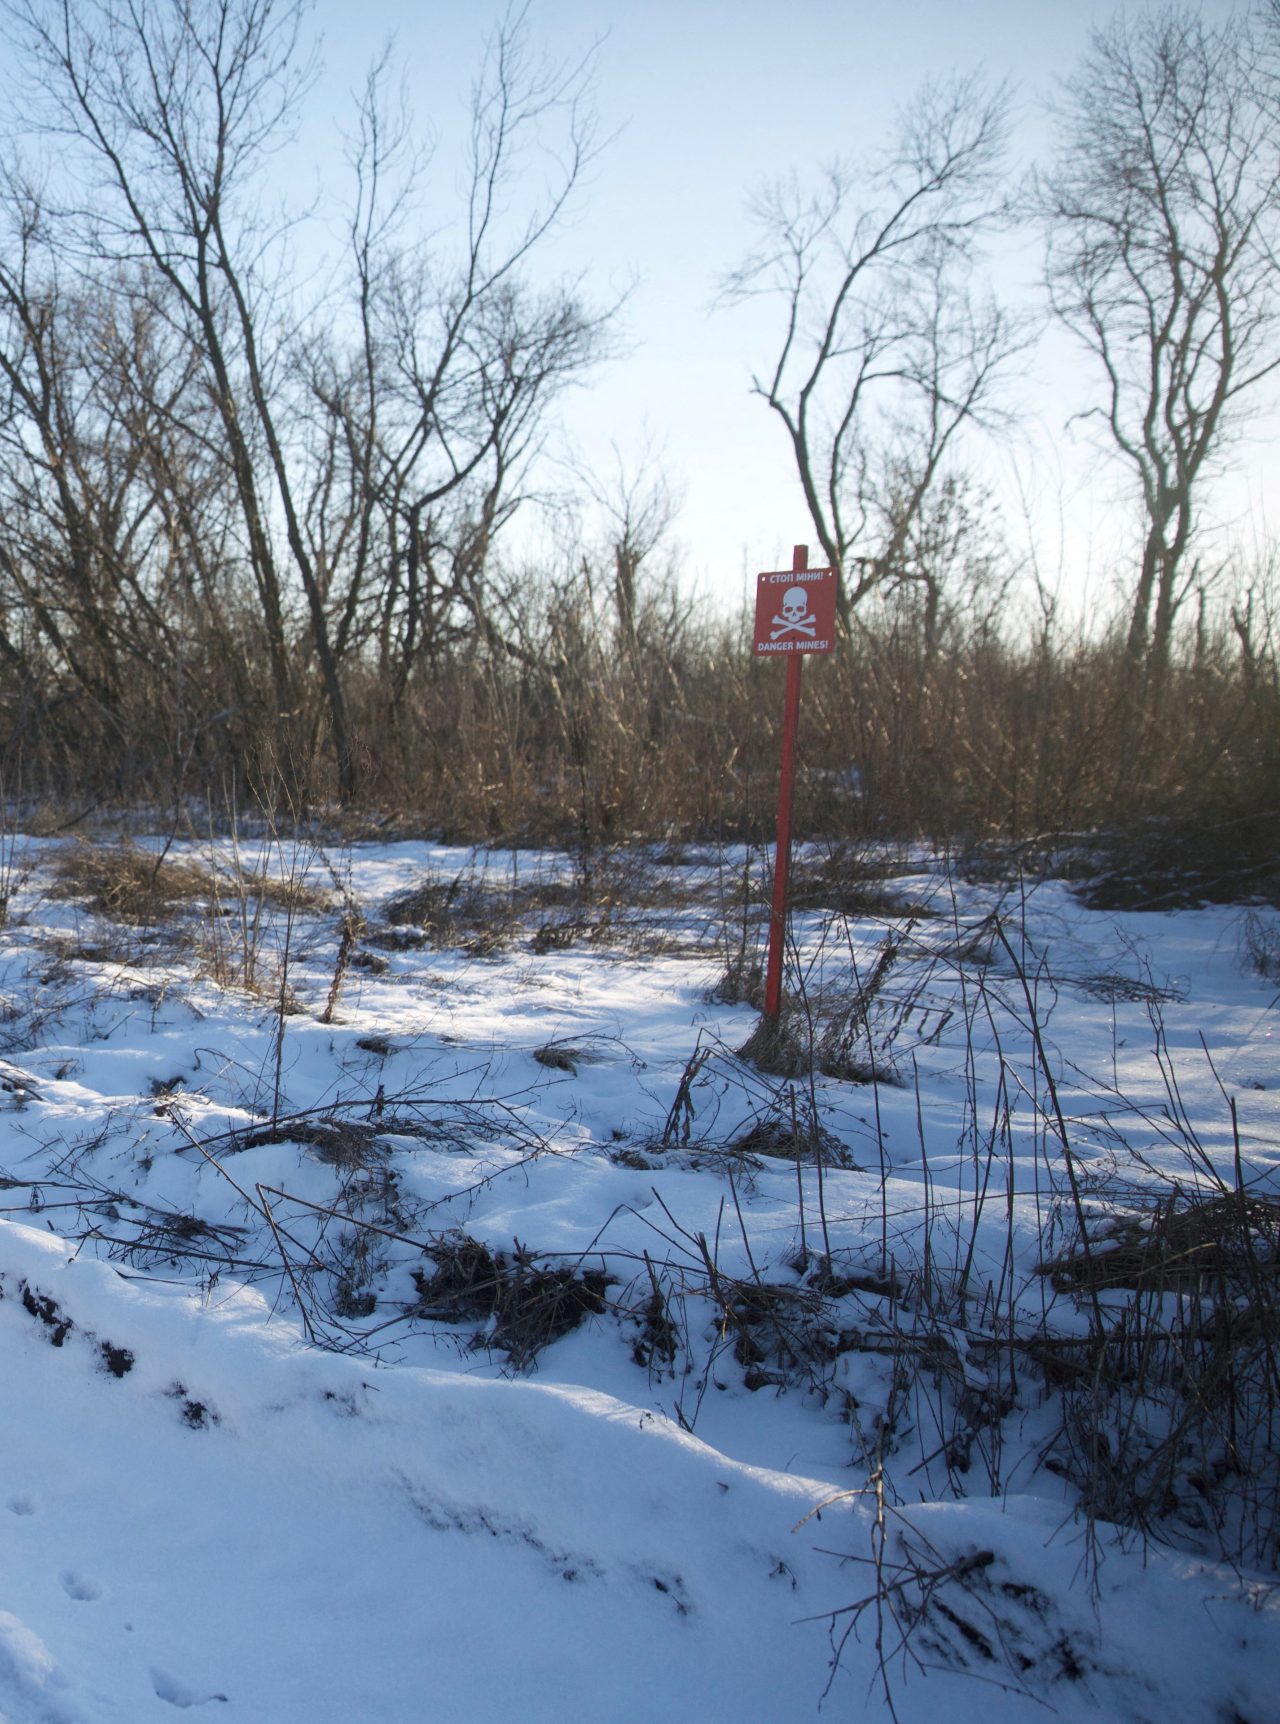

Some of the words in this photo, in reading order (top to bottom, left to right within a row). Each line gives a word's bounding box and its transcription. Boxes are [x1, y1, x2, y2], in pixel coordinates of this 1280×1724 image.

[770, 574, 793, 583] СТОП
[796, 571, 823, 582] МІНИ!
[758, 642, 793, 651] DANGER
[796, 640, 828, 650] MINES!
